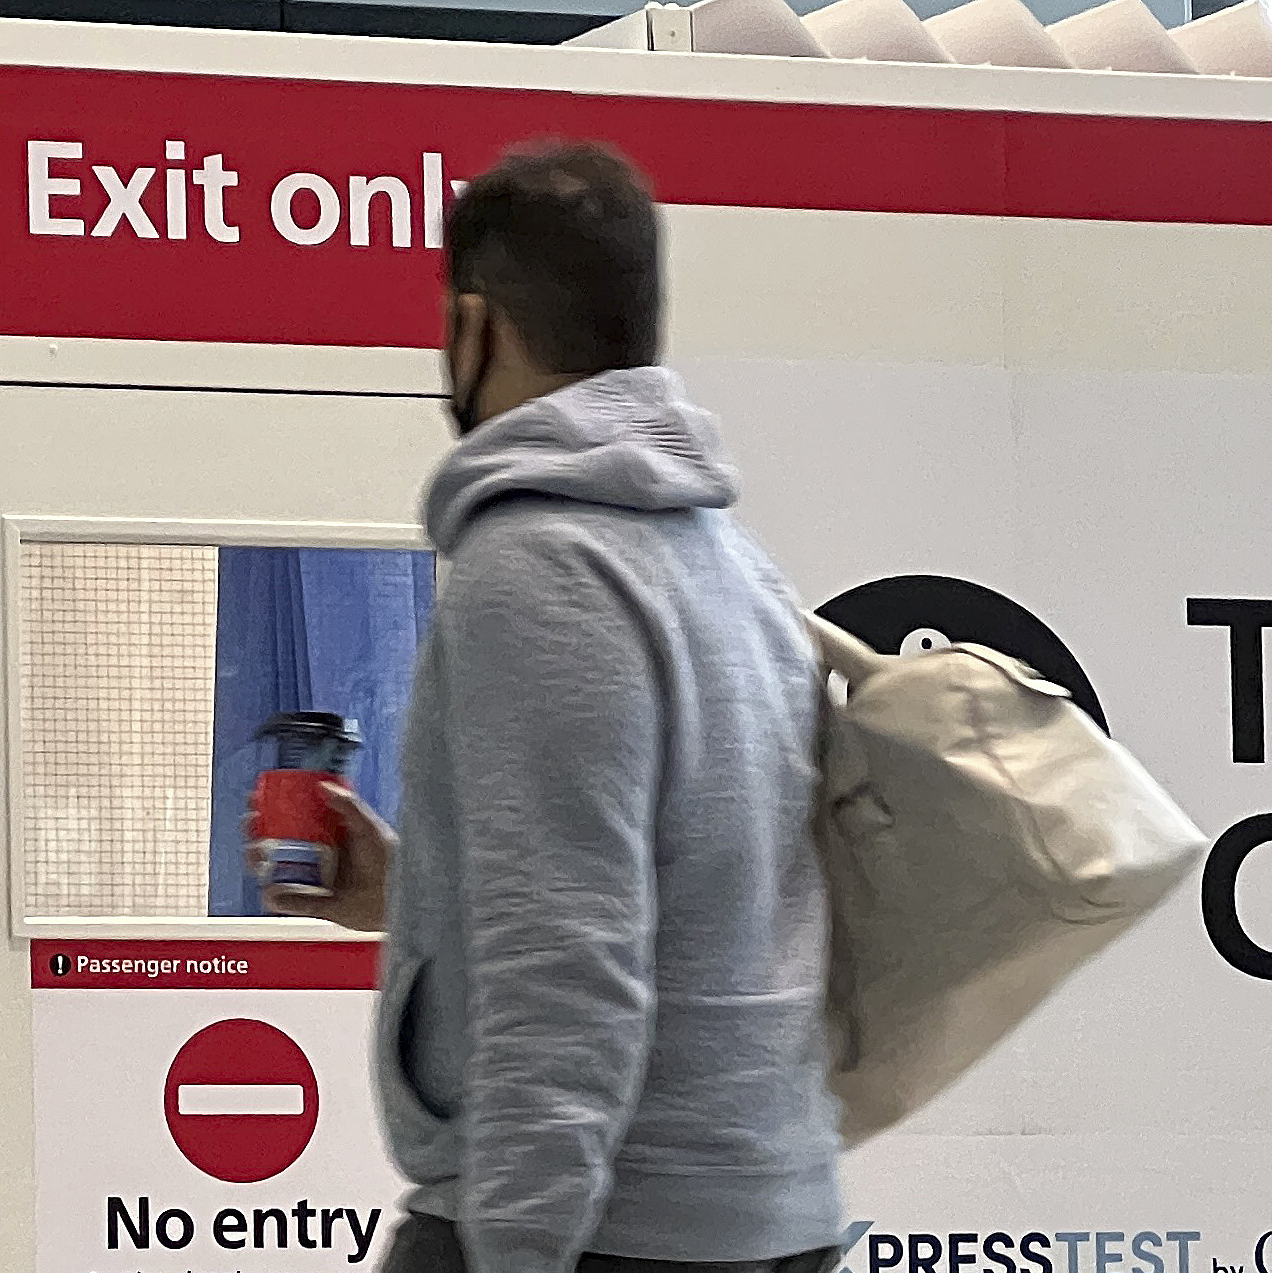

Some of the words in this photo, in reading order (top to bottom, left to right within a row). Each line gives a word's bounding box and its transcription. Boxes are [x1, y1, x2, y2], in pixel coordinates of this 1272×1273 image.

[28, 140, 239, 242] Exit
[271, 152, 469, 248] onl
[77, 955, 181, 977] Passenger
[186, 955, 248, 974] notice
[107, 1196, 194, 1250] No
[213, 1199, 382, 1263] entry
